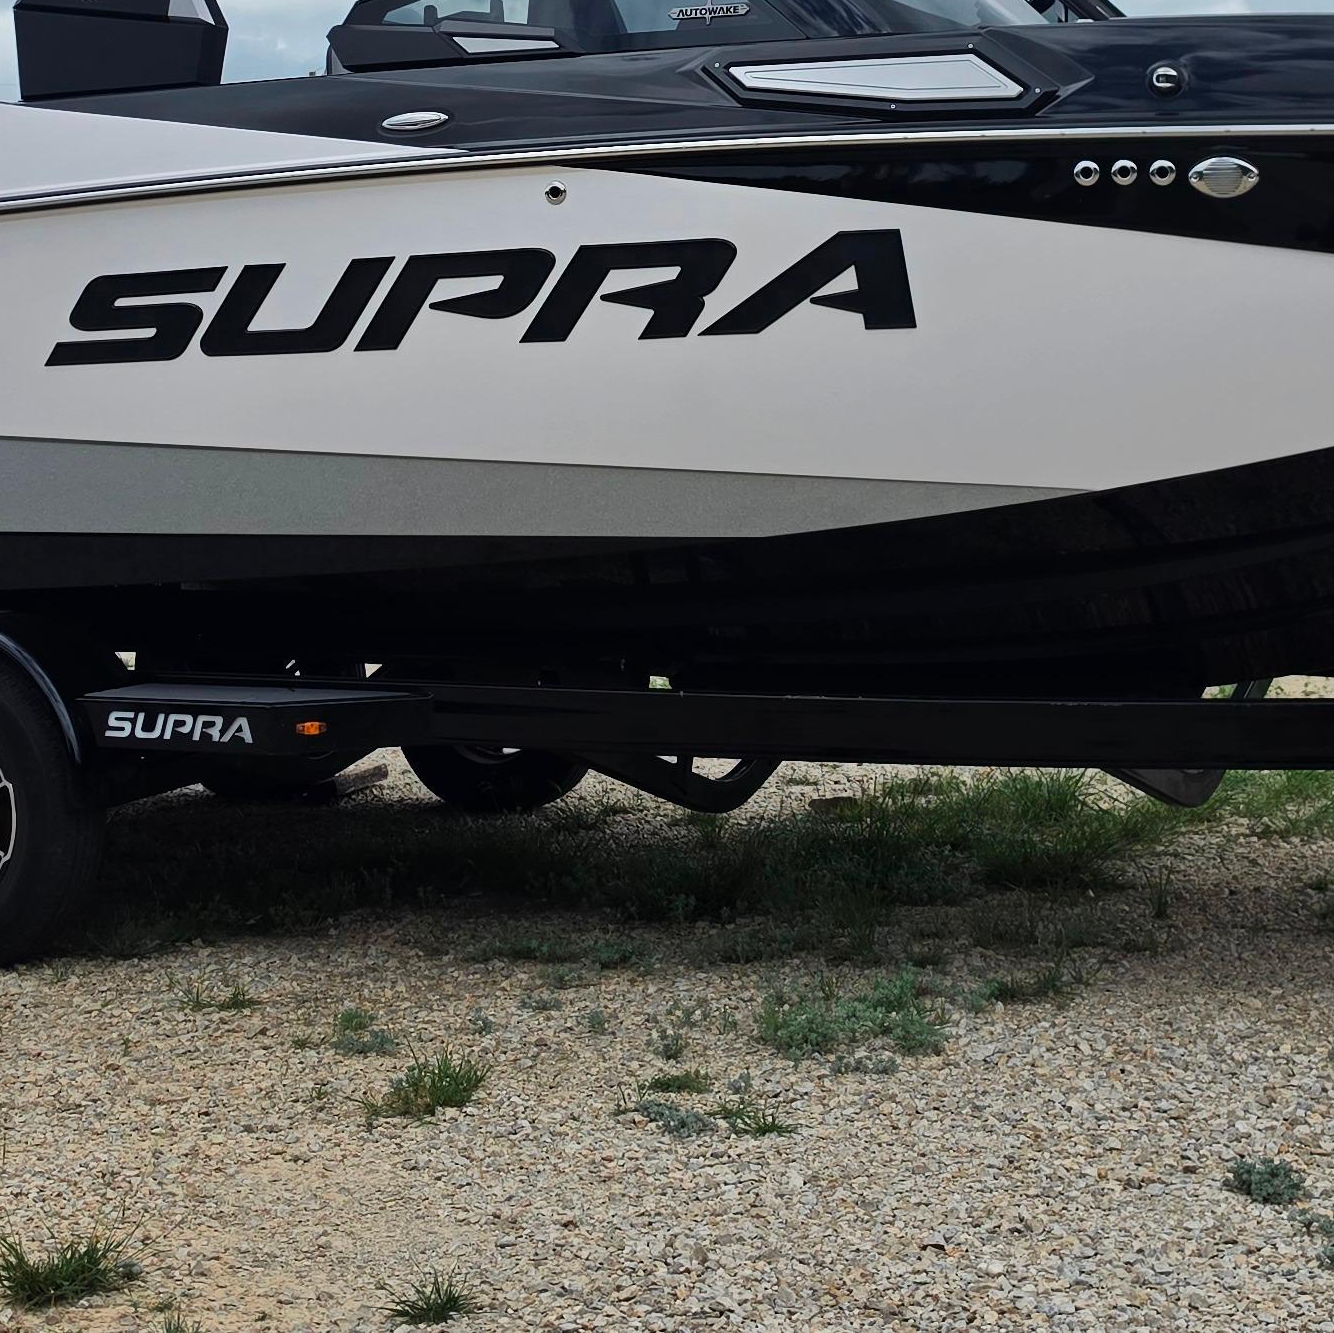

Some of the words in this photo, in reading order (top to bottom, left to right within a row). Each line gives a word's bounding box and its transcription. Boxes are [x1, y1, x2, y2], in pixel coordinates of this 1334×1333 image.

[676, 6, 740, 18] AUTOWAKE
[44, 228, 918, 367] SUPRA
[105, 711, 254, 744] SUPRA
